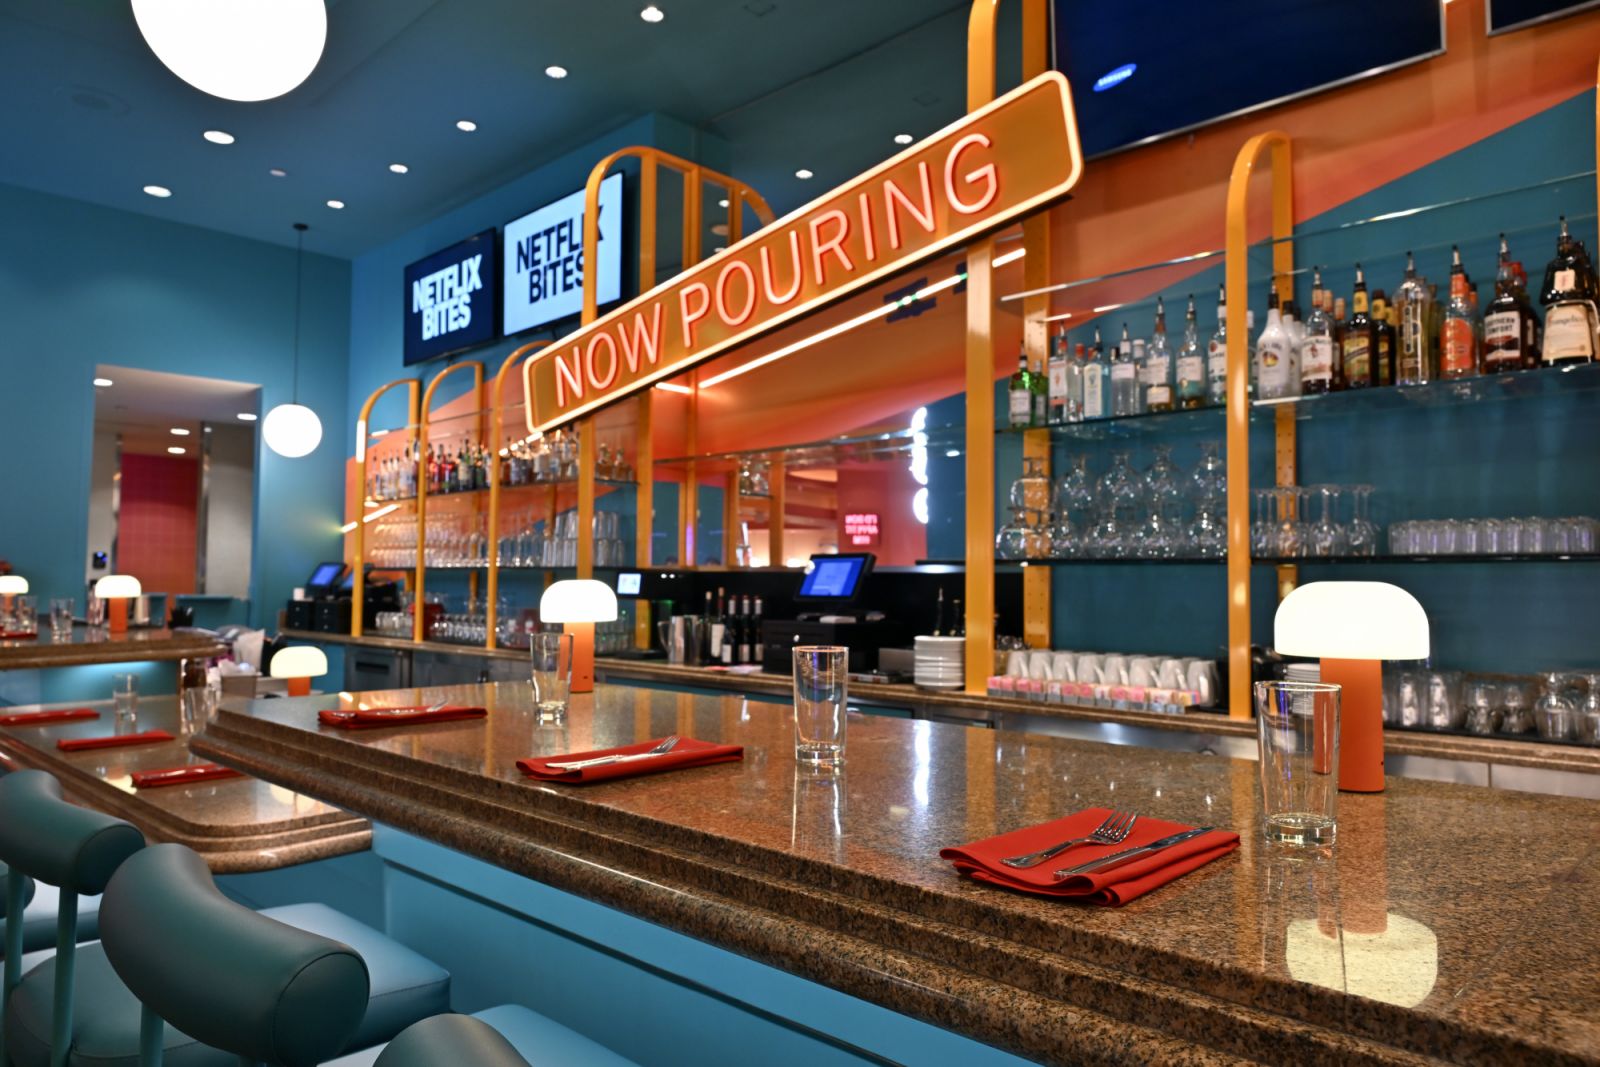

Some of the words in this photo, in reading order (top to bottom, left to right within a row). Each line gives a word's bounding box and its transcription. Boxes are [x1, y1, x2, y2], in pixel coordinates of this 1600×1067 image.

[412, 253, 483, 313] NETFLIX
[529, 250, 585, 304] BITES
[554, 302, 663, 409] NOW
[679, 132, 1000, 349] POURING
[421, 293, 472, 341] BITES
